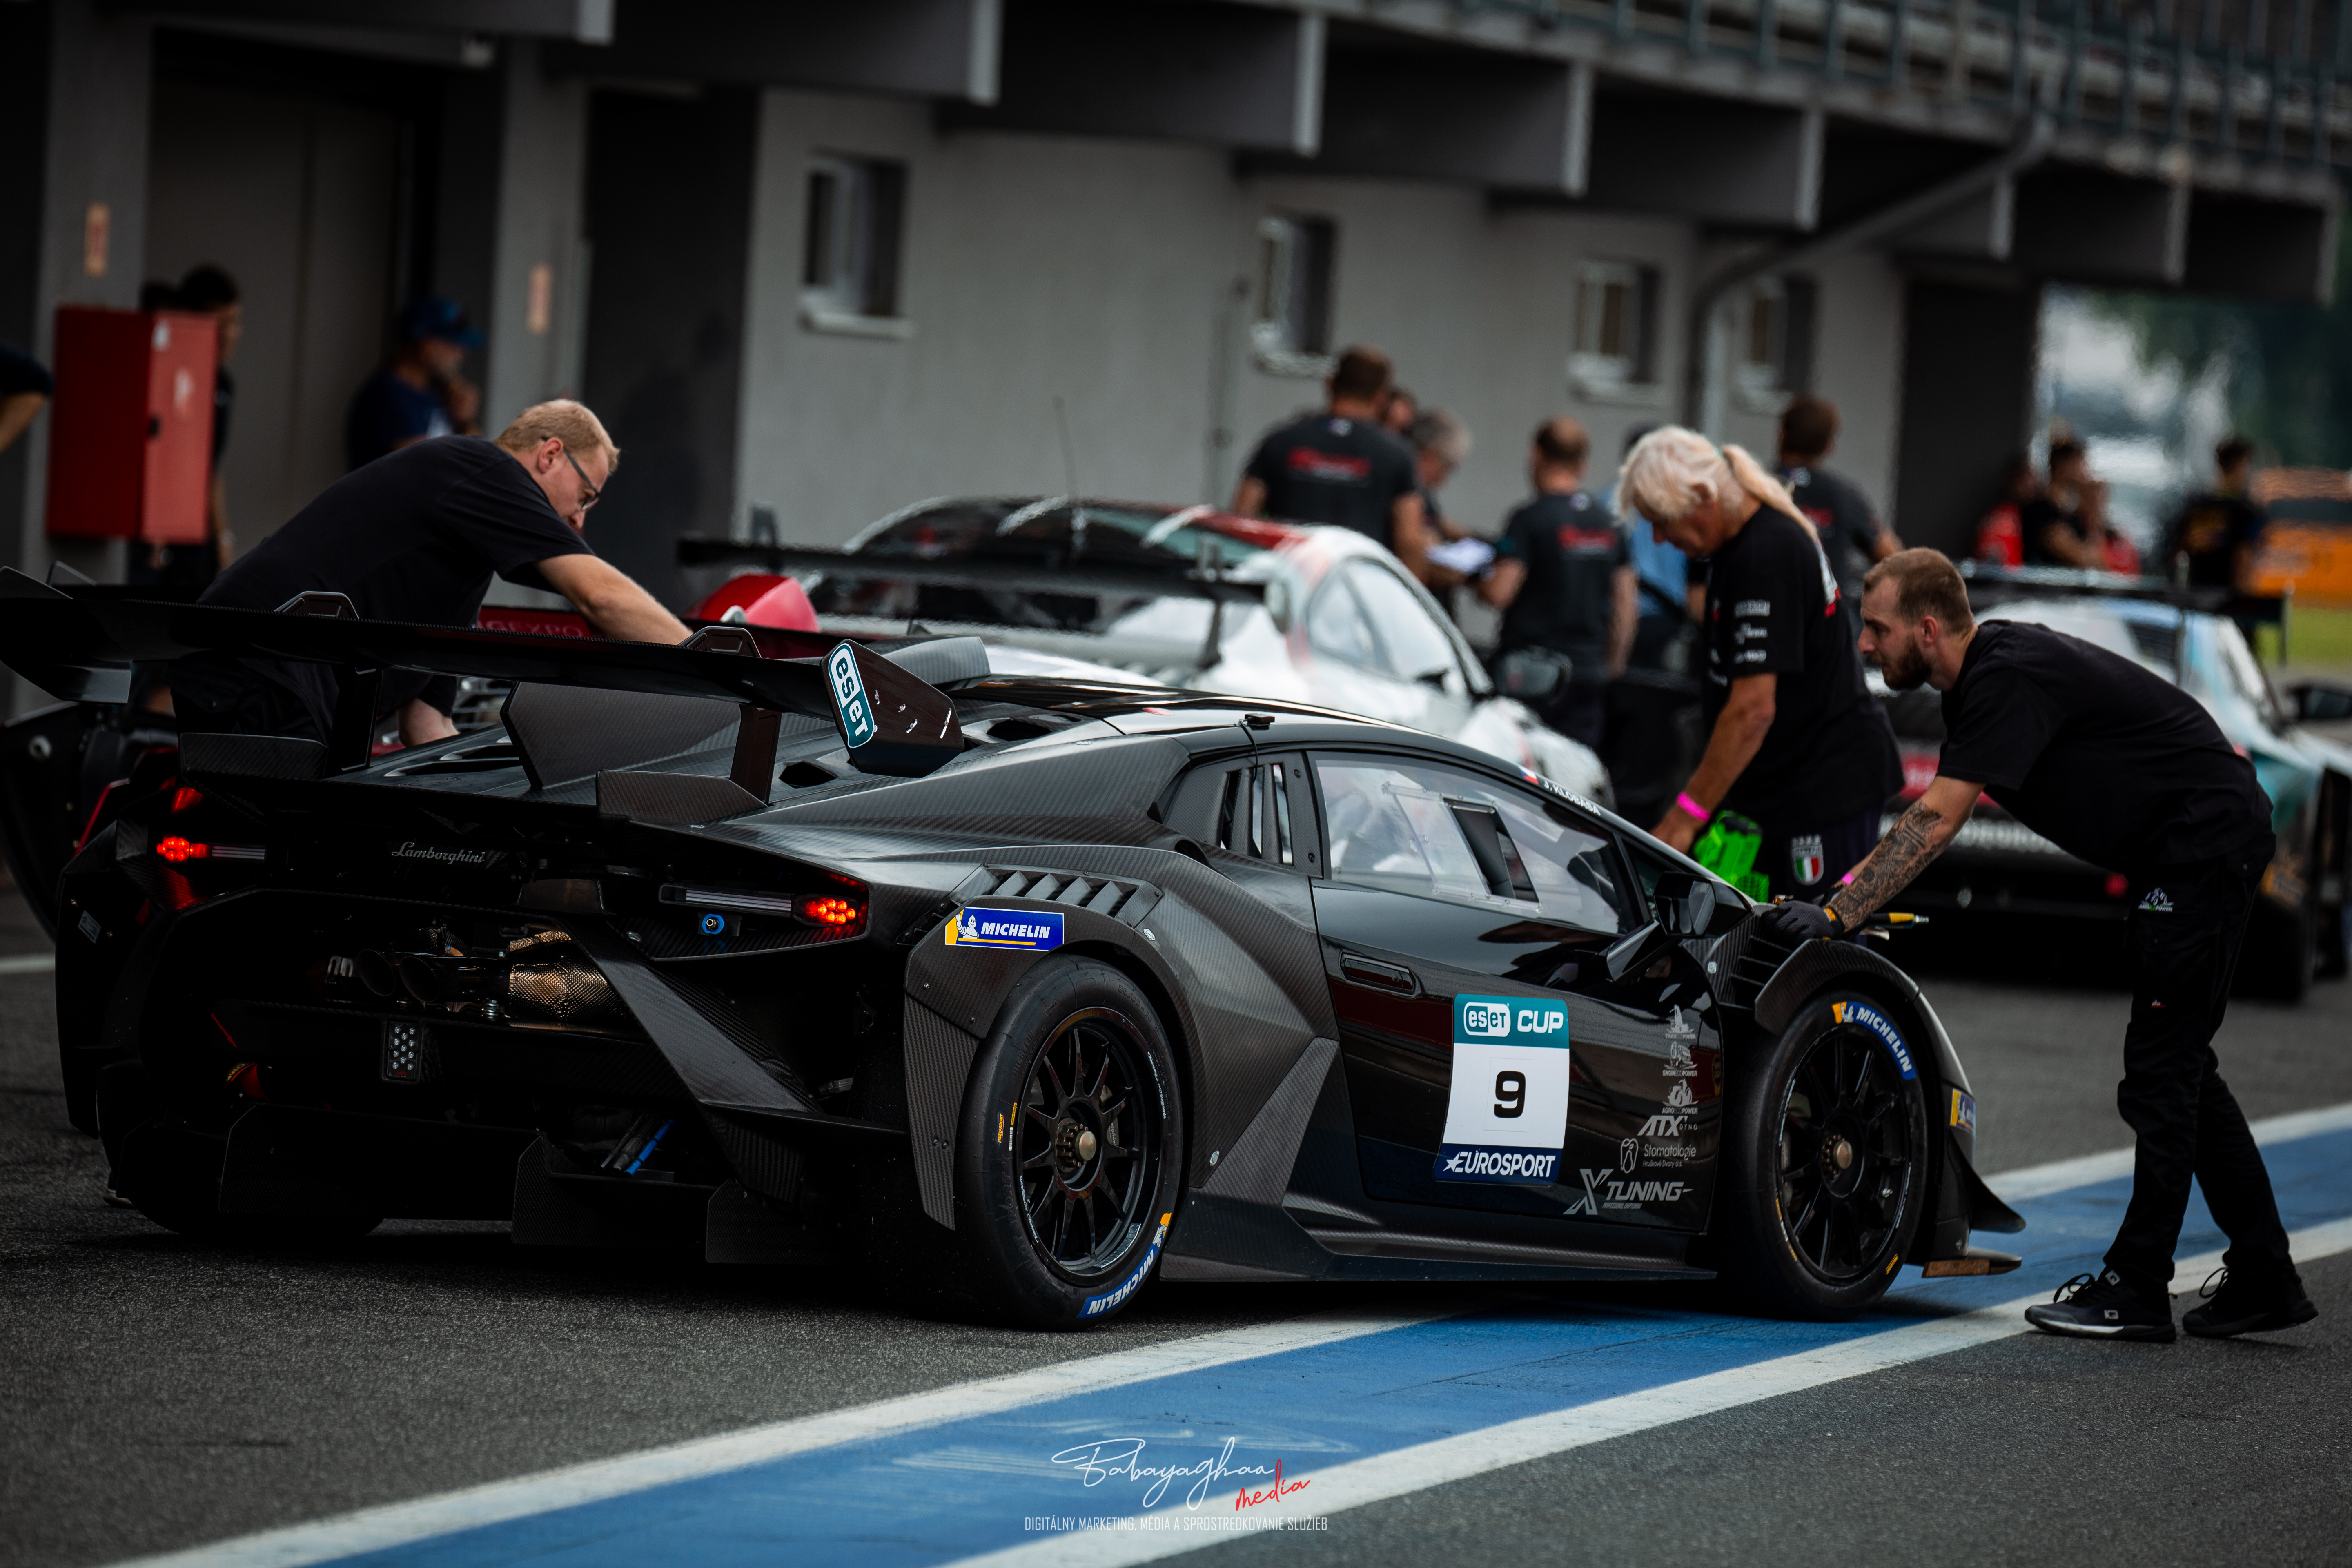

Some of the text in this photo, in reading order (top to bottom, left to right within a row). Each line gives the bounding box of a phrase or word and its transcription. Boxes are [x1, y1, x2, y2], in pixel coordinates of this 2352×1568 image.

[391, 841, 486, 865] Lamborghini
[980, 922, 1051, 939] MICHELIN
[1517, 1010, 1564, 1034] CUP
[1856, 1006, 1913, 1073] MICHELIN
[1493, 1070, 1526, 1119] 9
[1637, 1115, 1684, 1136] ATX
[1644, 1143, 1697, 1161] Stomatologie
[1662, 1159, 1675, 1169] Dvory
[1454, 1152, 1556, 1178] EUROSPORT
[1087, 1249, 1154, 1315] MICHELIN
